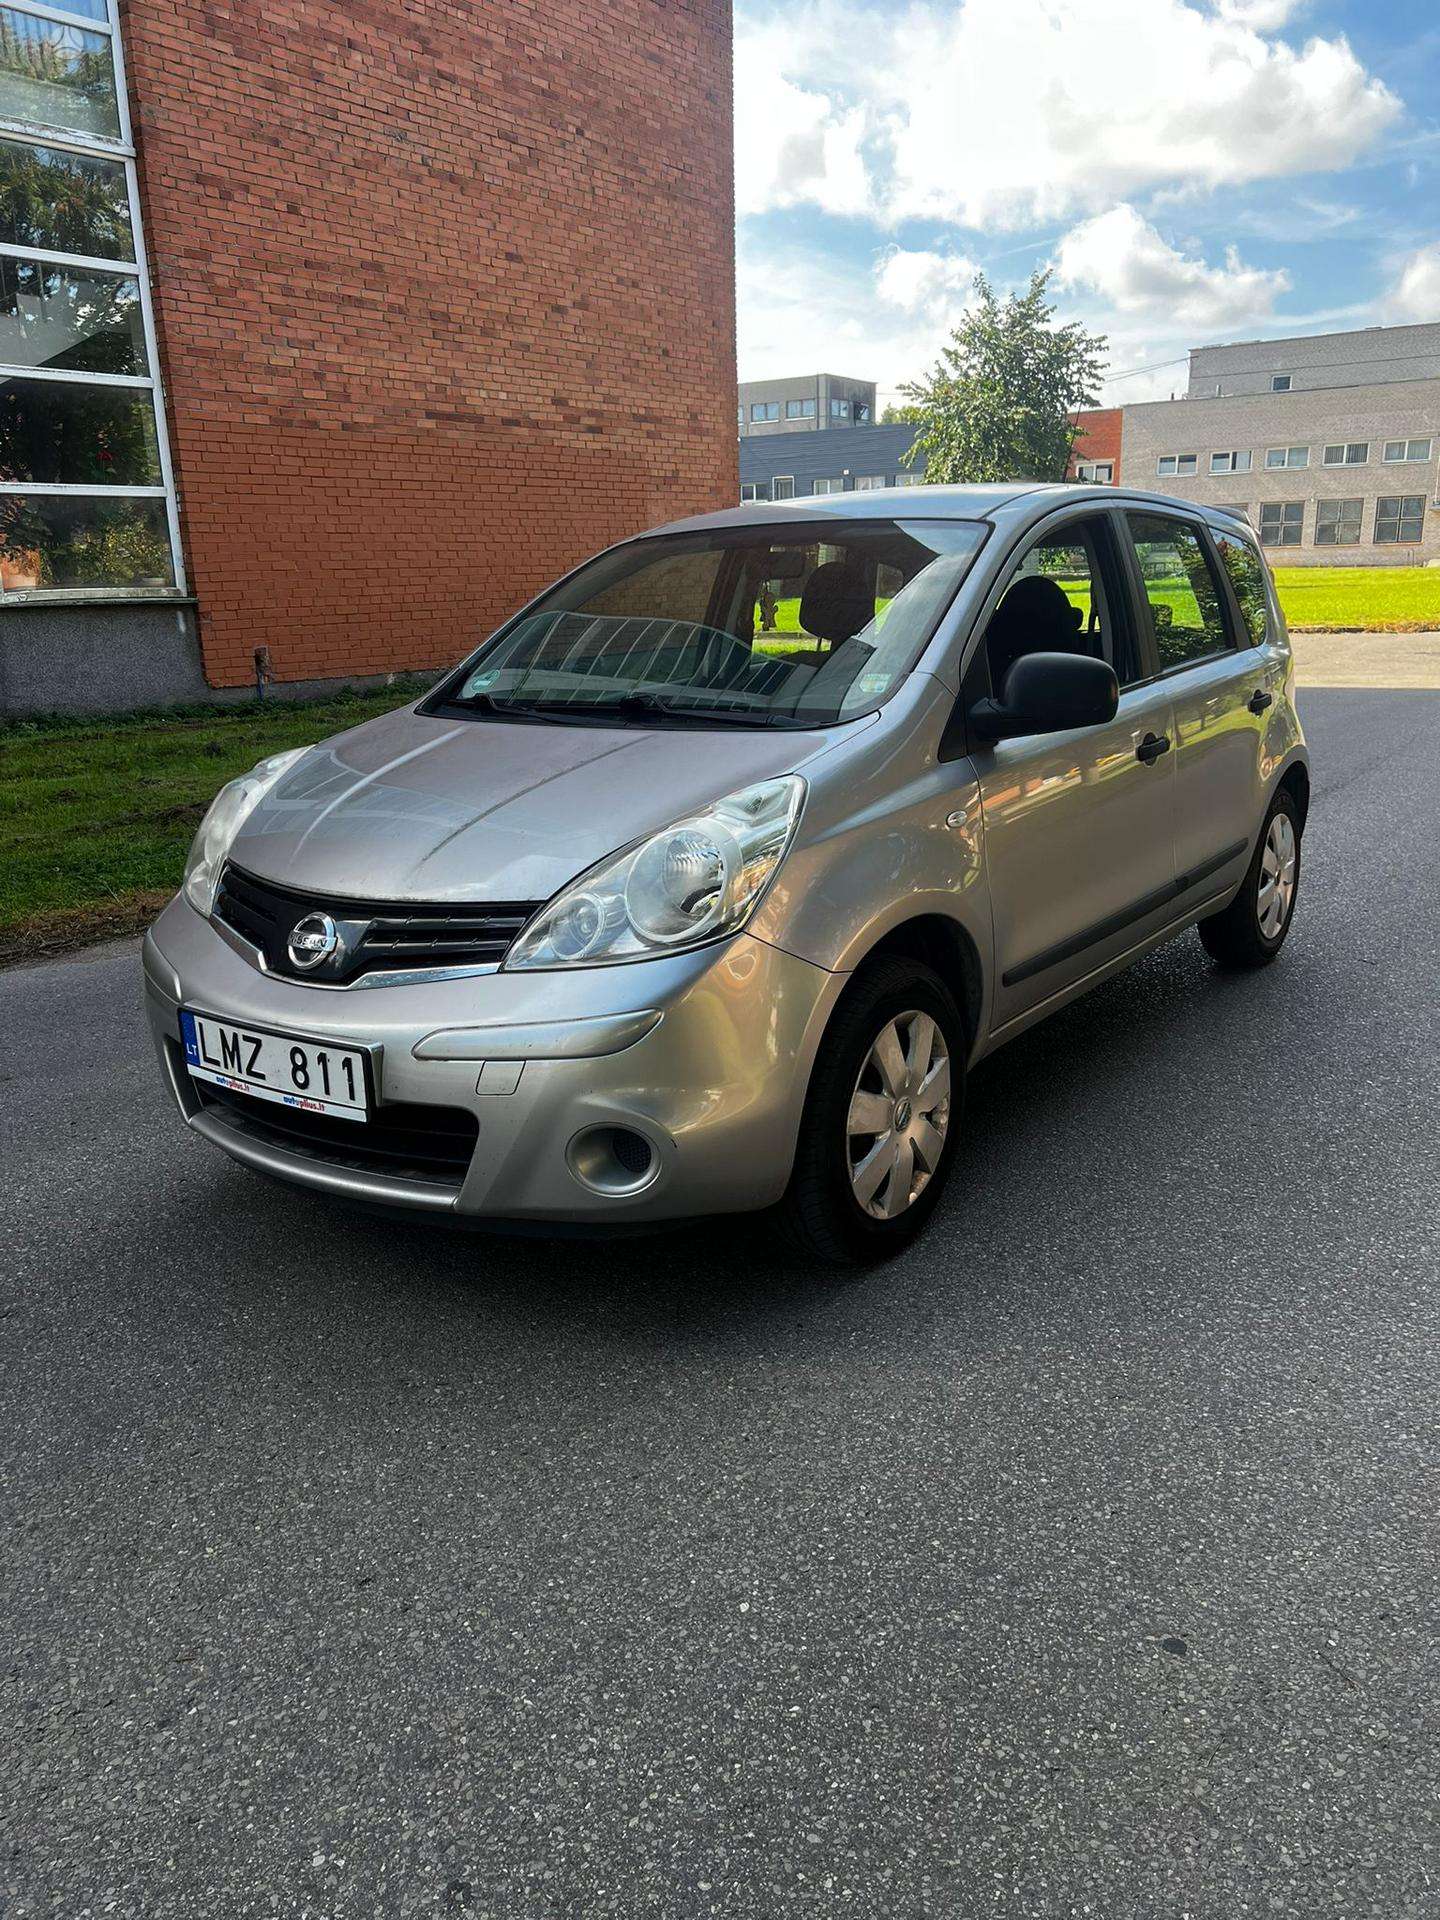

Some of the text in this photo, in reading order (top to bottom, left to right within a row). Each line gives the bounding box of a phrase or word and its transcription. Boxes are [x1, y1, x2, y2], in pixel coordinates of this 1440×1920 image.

[186, 1042, 197, 1056] LT
[198, 1022, 356, 1100] LMZ 811
